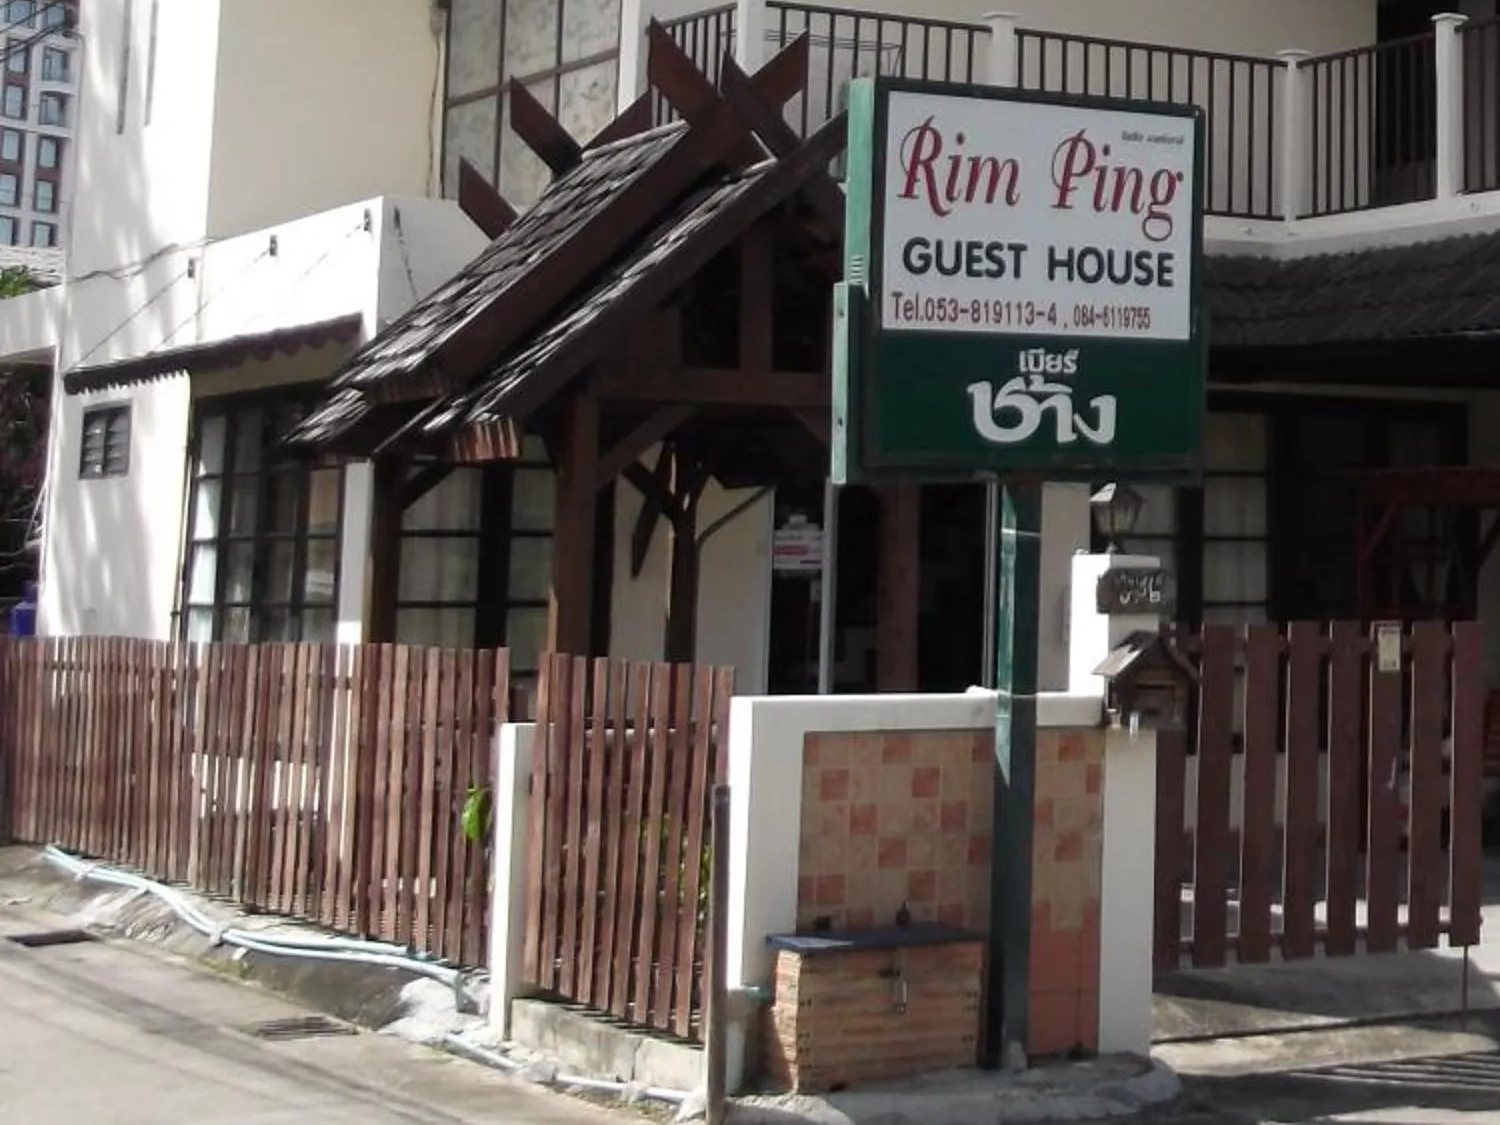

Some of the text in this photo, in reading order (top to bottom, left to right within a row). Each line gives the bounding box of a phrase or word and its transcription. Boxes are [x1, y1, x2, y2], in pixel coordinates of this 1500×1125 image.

[896, 114, 1184, 242] Rim Ping
[902, 236, 1174, 287] GUEST HOUSE
[1019, 347, 1080, 373] เบียร์
[966, 374, 1117, 443] ช้าง
